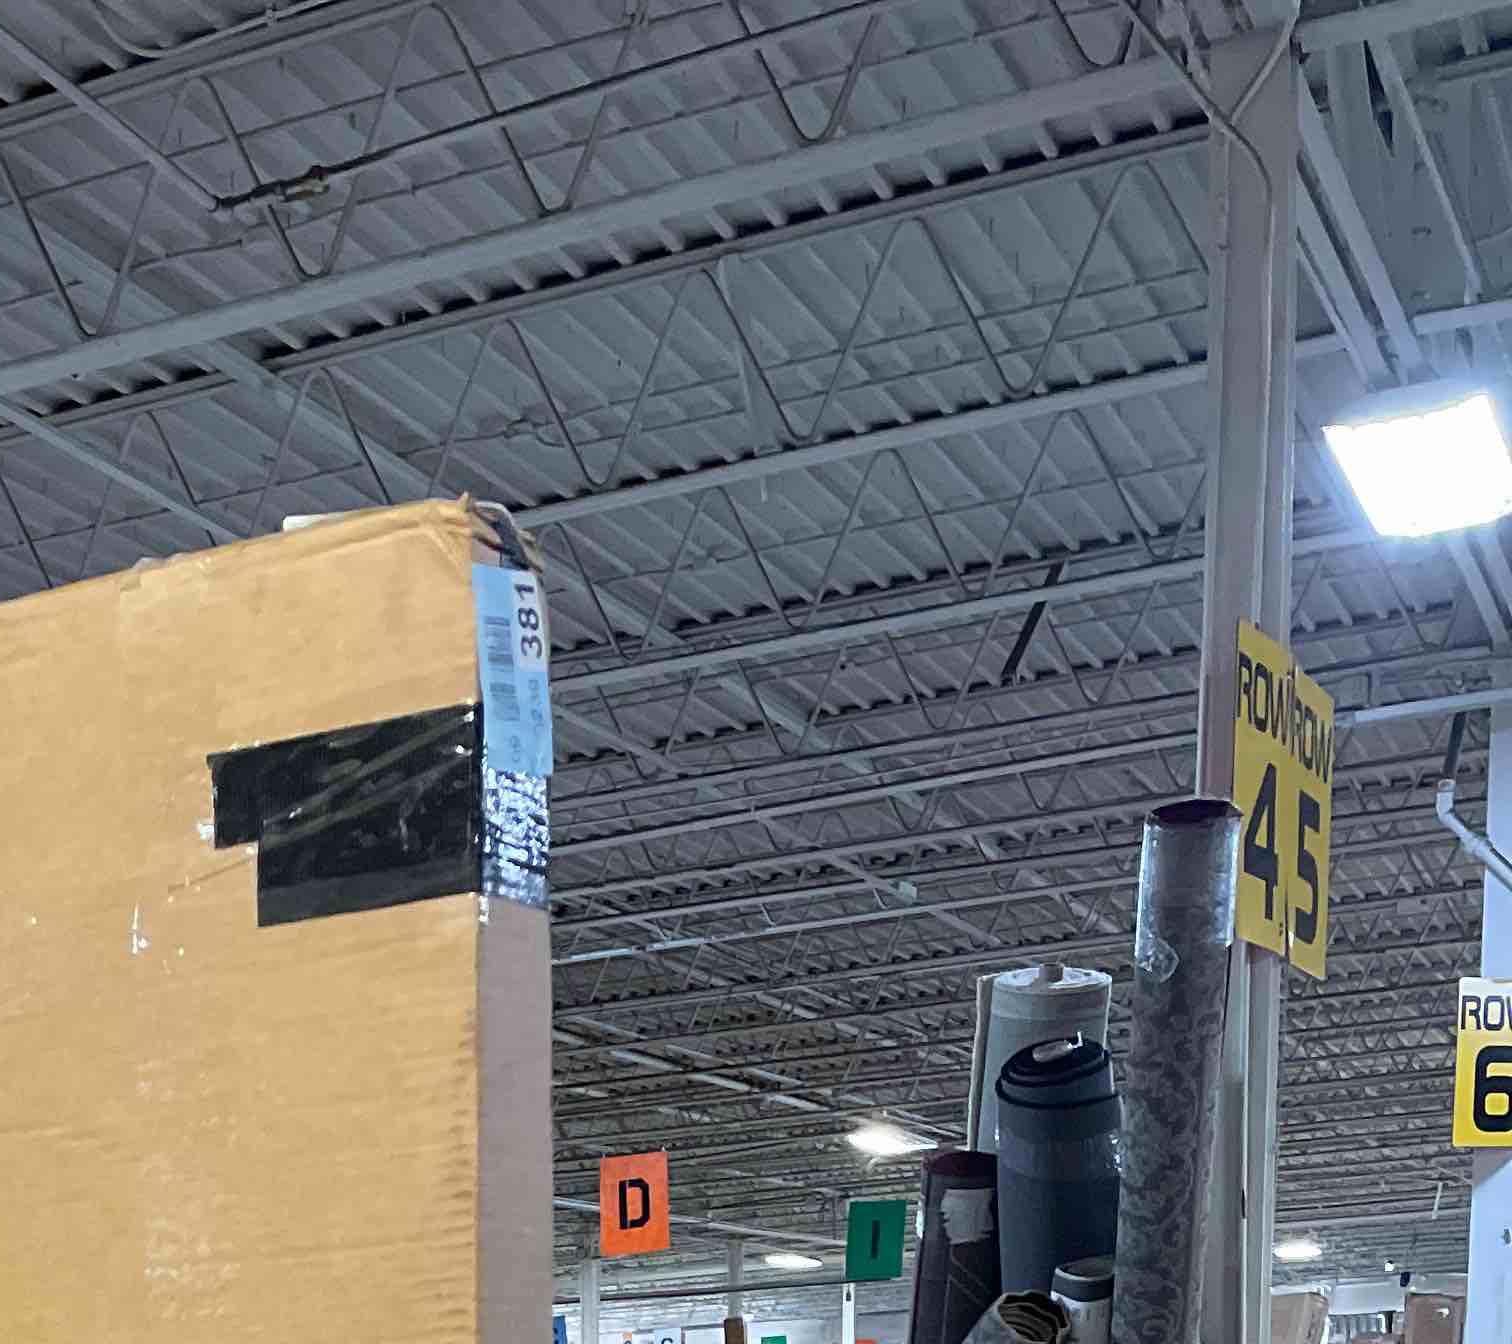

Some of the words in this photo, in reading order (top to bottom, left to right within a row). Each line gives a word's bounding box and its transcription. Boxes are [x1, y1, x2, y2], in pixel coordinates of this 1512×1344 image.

[514, 583, 542, 660] 381
[1238, 652, 1291, 746] ROW
[1244, 762, 1278, 921] 4
[1295, 790, 1320, 944] 5
[1473, 1045, 1512, 1132] 6
[618, 1178, 650, 1230] D
